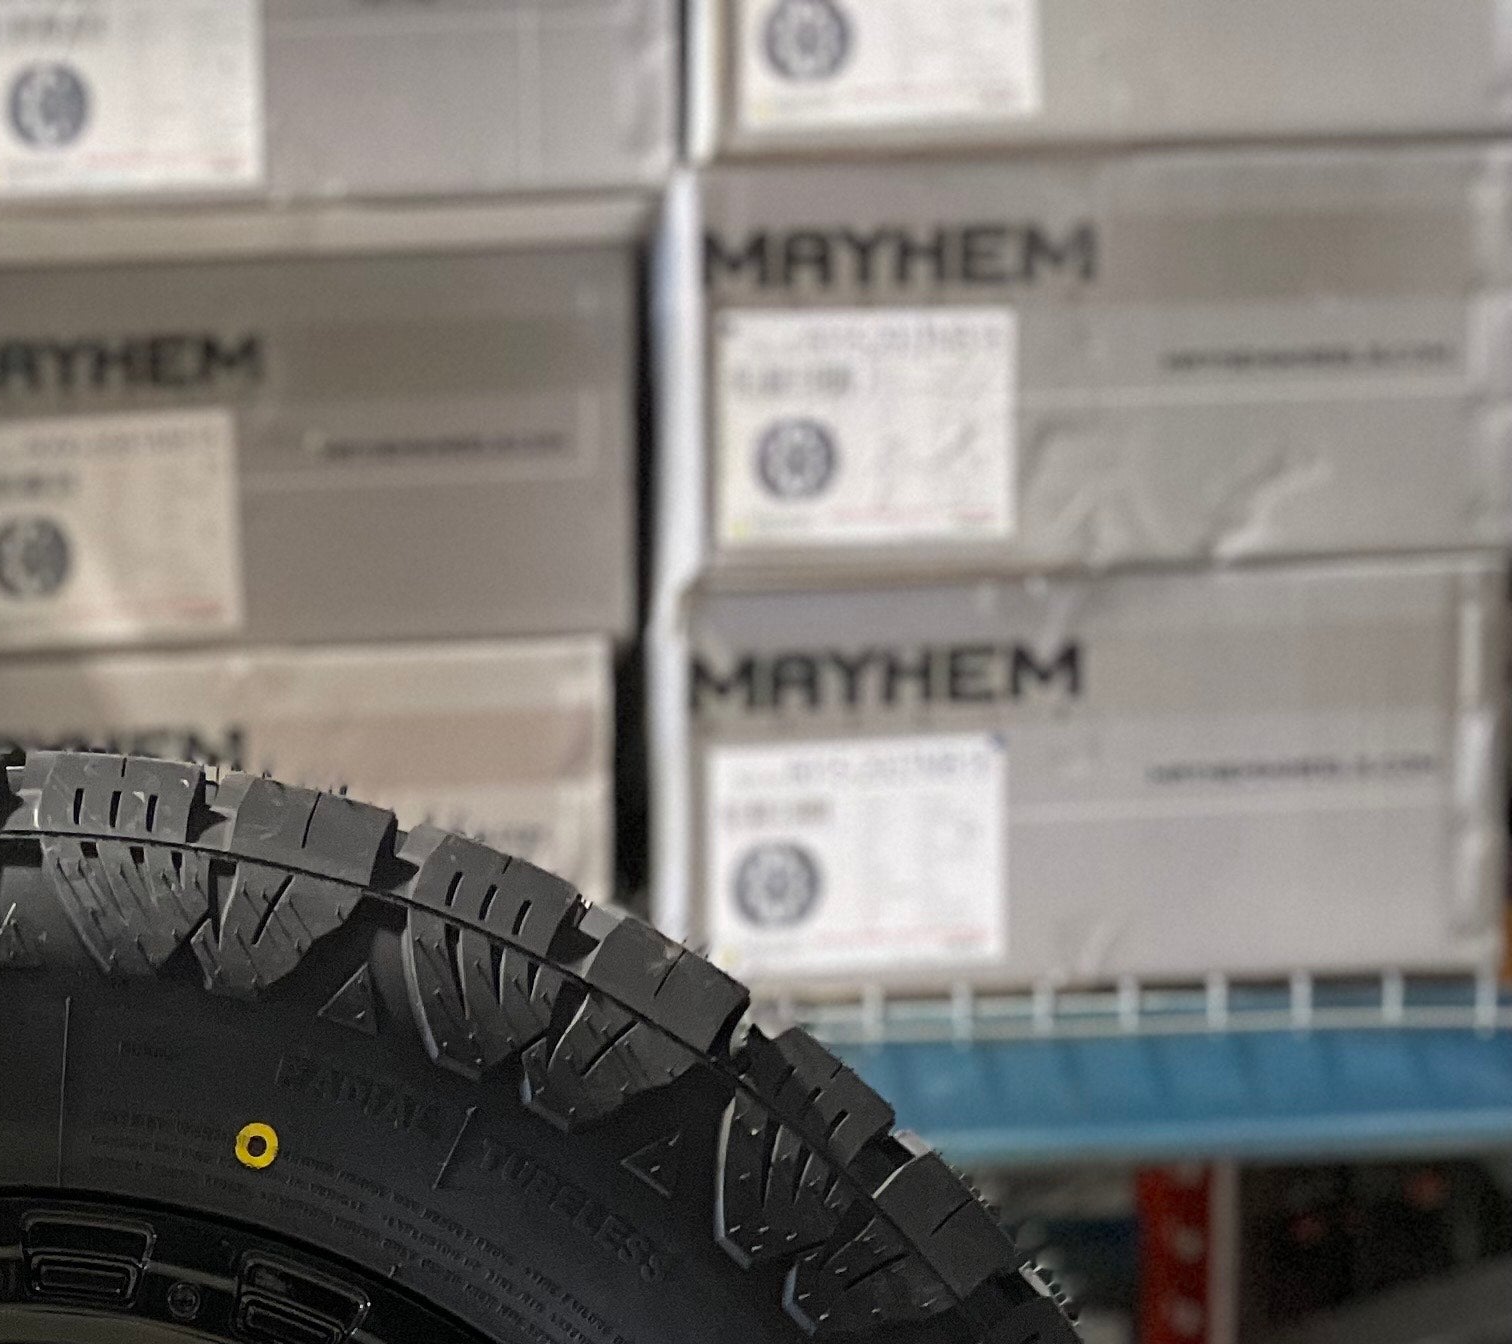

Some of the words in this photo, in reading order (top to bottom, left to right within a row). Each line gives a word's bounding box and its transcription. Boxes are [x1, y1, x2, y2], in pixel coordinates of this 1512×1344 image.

[704, 219, 1098, 290] MAYHEM
[690, 637, 1084, 714] MAYHEM
[478, 1137, 666, 1285] TUBELESS
